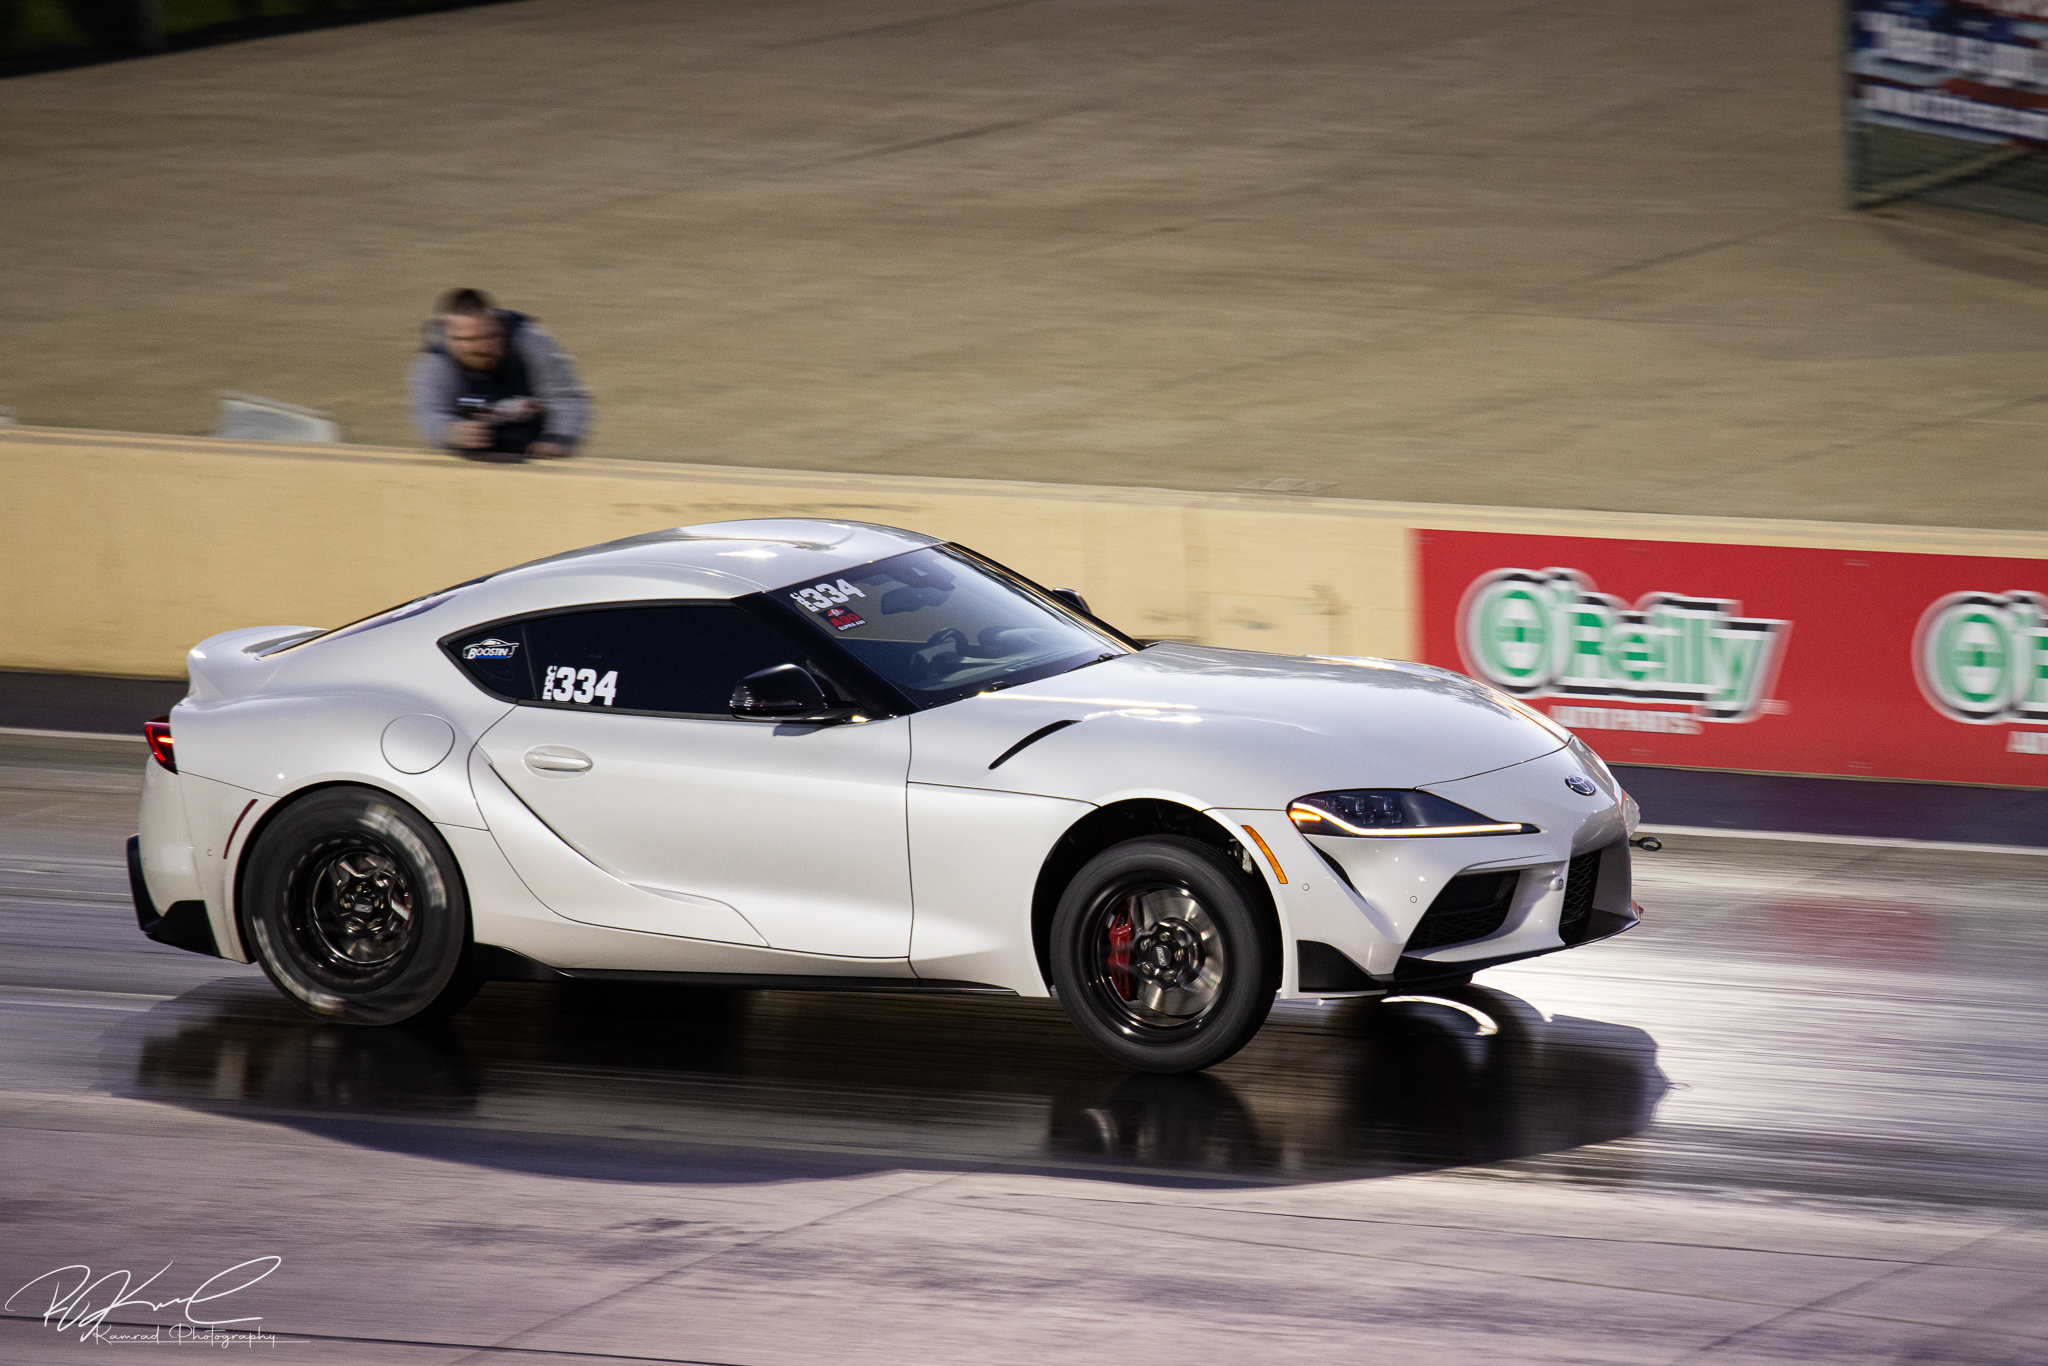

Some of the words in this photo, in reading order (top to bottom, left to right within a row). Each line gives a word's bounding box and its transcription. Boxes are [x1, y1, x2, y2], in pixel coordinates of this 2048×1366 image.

[799, 579, 866, 608] 334
[830, 613, 860, 627] A90
[467, 648, 509, 659] BOOSTIN
[552, 666, 618, 706] 334
